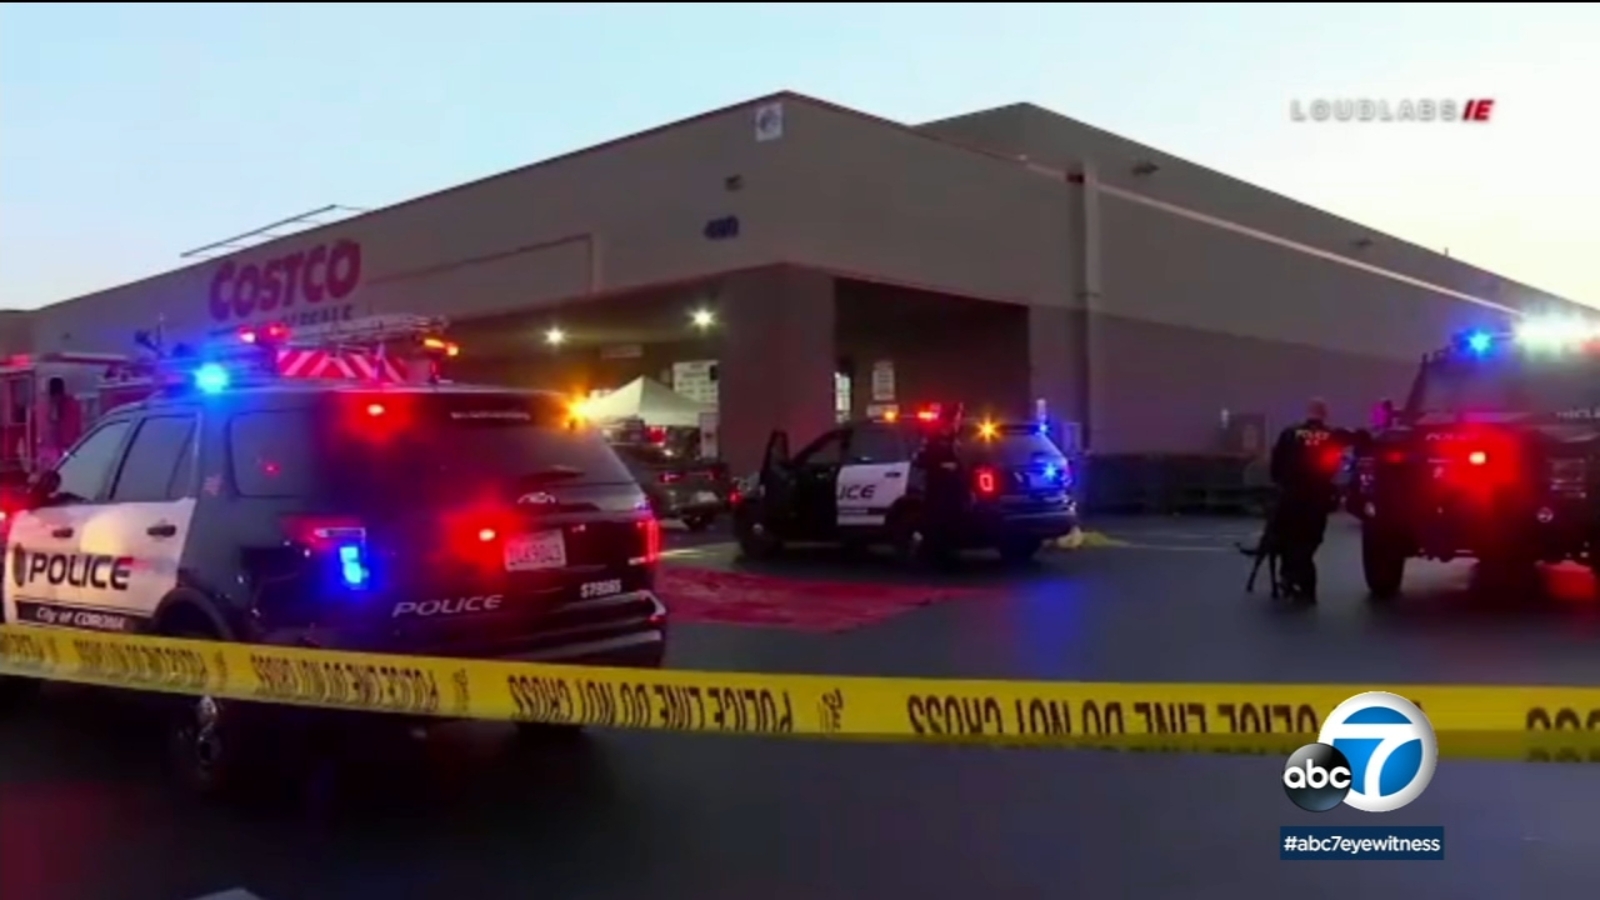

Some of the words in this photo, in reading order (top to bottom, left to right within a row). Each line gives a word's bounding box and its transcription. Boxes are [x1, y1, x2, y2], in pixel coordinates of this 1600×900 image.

[208, 238, 361, 322] COSTCO
[29, 552, 134, 591] POLICE
[37, 607, 56, 623] City
[392, 595, 503, 617] POLICE
[508, 675, 574, 723] CROSS
[577, 678, 617, 727] NOT
[620, 682, 651, 728] DO
[653, 685, 706, 730] LINE
[708, 687, 794, 734] POLICE
